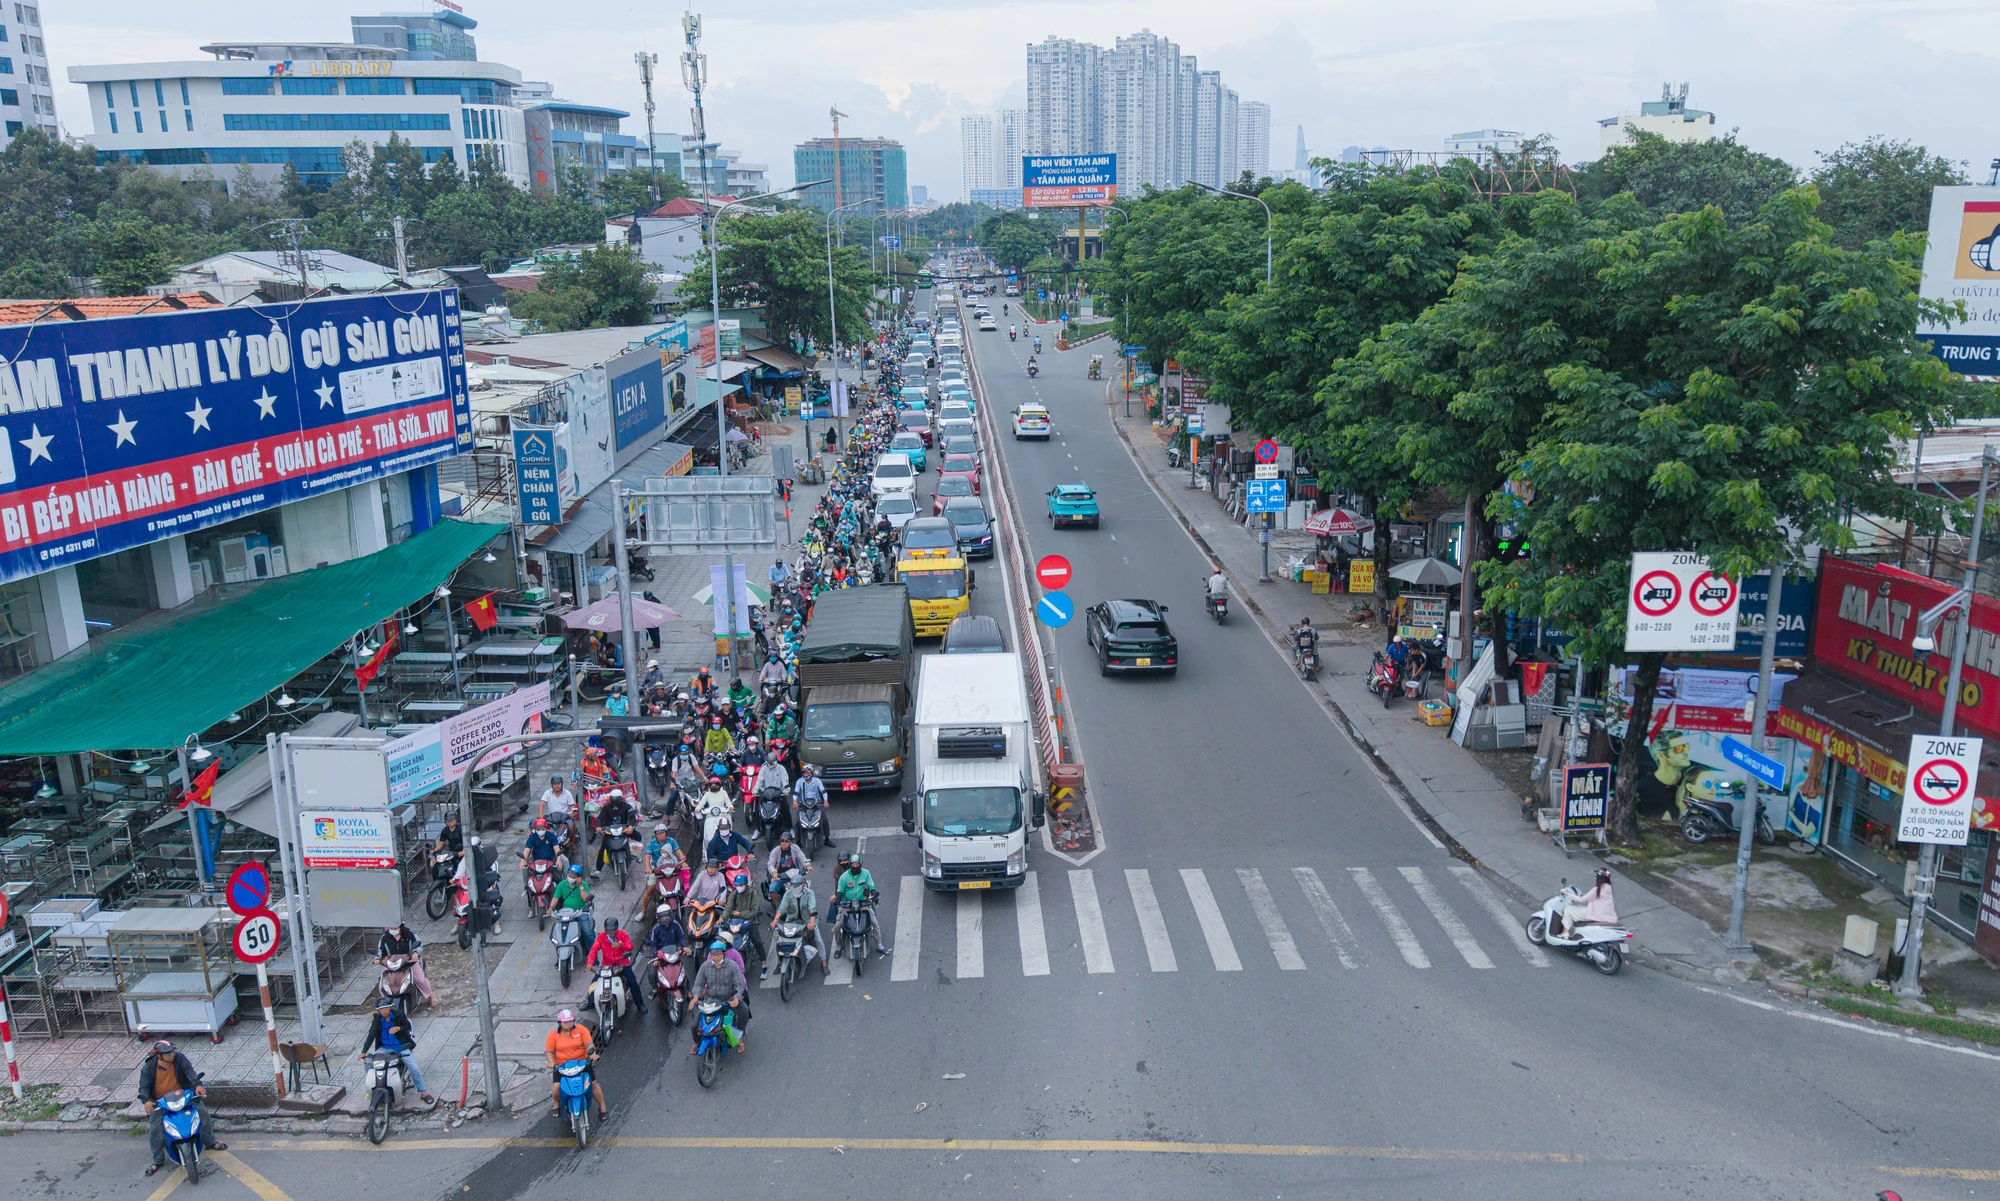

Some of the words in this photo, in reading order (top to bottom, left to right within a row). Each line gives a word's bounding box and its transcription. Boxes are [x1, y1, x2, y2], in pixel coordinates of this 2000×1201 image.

[311, 61, 392, 76] LIBRARY
[1031, 158, 1052, 168] BỆNH
[1054, 158, 1072, 168] VIỆN
[1074, 156, 1090, 166] TÂM
[1092, 157, 1110, 165] ANH
[1037, 175, 1056, 184] TÂM
[1078, 175, 1102, 184] QUẬN
[1952, 284, 1985, 298] CHẤT
[1942, 346, 1991, 360] TRUNG
[0, 353, 62, 416] ÂM
[69, 342, 202, 403] THANH
[206, 330, 242, 384] LÝ
[246, 318, 291, 378] ĐỒ
[301, 321, 340, 370] CŨ
[345, 316, 389, 362] SÀI
[393, 312, 441, 356] GÒN
[616, 385, 638, 416] LIEN
[640, 381, 646, 404] A
[524, 468, 550, 480] NỆM
[2, 504, 32, 544] BỊ
[32, 486, 74, 534] BẾP
[76, 480, 121, 524] NHÀ
[122, 472, 176, 512] HÀNG
[193, 458, 230, 496] BÀN
[231, 442, 264, 486] GHẾ
[274, 437, 316, 476] QUÁN
[318, 432, 338, 464] CÀ
[338, 424, 364, 459] PHÊ
[373, 418, 398, 450] TRÀ
[523, 482, 554, 493] CHĂN
[532, 498, 547, 507] GA
[156, 518, 176, 529] Trung
[193, 507, 214, 519] Thanh
[531, 508, 550, 521] GỐI
[1672, 555, 1705, 565] ZONE
[1352, 562, 1364, 572] SỬA
[1366, 564, 1374, 572] XE
[1748, 592, 1759, 601] VỆ
[1838, 581, 1912, 640] MẮT
[1635, 623, 1648, 631] 6:00
[1655, 623, 1672, 631] 22:00
[1695, 623, 1708, 631] 6:00
[1717, 622, 1730, 631] 9:00
[1690, 635, 1706, 643] 16:00
[1713, 635, 1730, 643] 20:00
[1846, 637, 1876, 664] KỸ
[1876, 648, 1940, 692] THUẬT
[1938, 675, 1982, 708] CO
[1803, 704, 1815, 715] 663
[450, 729, 480, 747] COFFEE
[482, 720, 501, 734] EXPO
[451, 737, 487, 756] VIETNAM
[488, 728, 505, 741] 2025
[1781, 715, 1804, 736] GIẢM
[1830, 737, 1856, 766] 30%
[1869, 759, 1888, 780] THU
[1926, 741, 1967, 756] ZONE
[408, 766, 420, 777] 2025
[1572, 770, 1603, 794] MẮT
[1568, 796, 1603, 817] KÍNH
[1928, 808, 1937, 816] TÔ
[1938, 808, 1964, 817] KHÁCH
[338, 818, 372, 826] ROYAL
[1918, 816, 1946, 826] GIƯỜNG
[1948, 817, 1964, 826] NẰM
[339, 828, 380, 836] SCHOOL
[1902, 826, 1925, 838] 6:00
[1934, 828, 1965, 840] 22:00
[246, 922, 269, 950] 50
